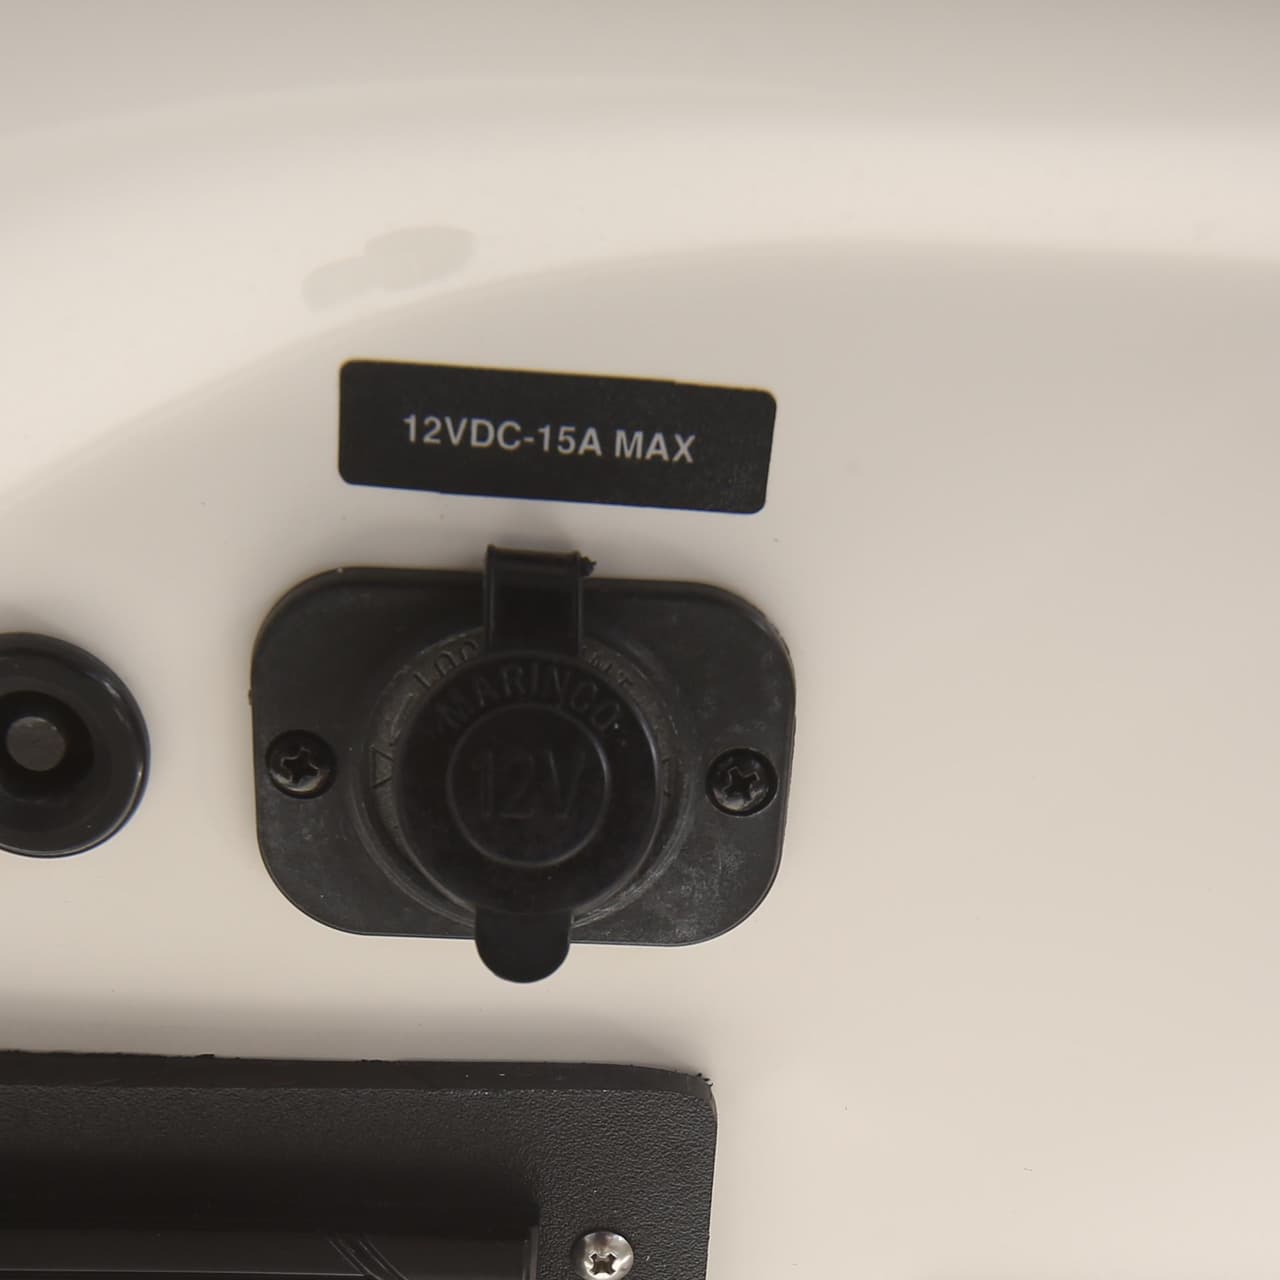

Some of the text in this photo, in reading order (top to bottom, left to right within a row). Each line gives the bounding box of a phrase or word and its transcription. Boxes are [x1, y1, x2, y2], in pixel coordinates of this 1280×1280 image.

[402, 414, 696, 463] 12VDC-15A MAX
[471, 738, 588, 821] 12V
